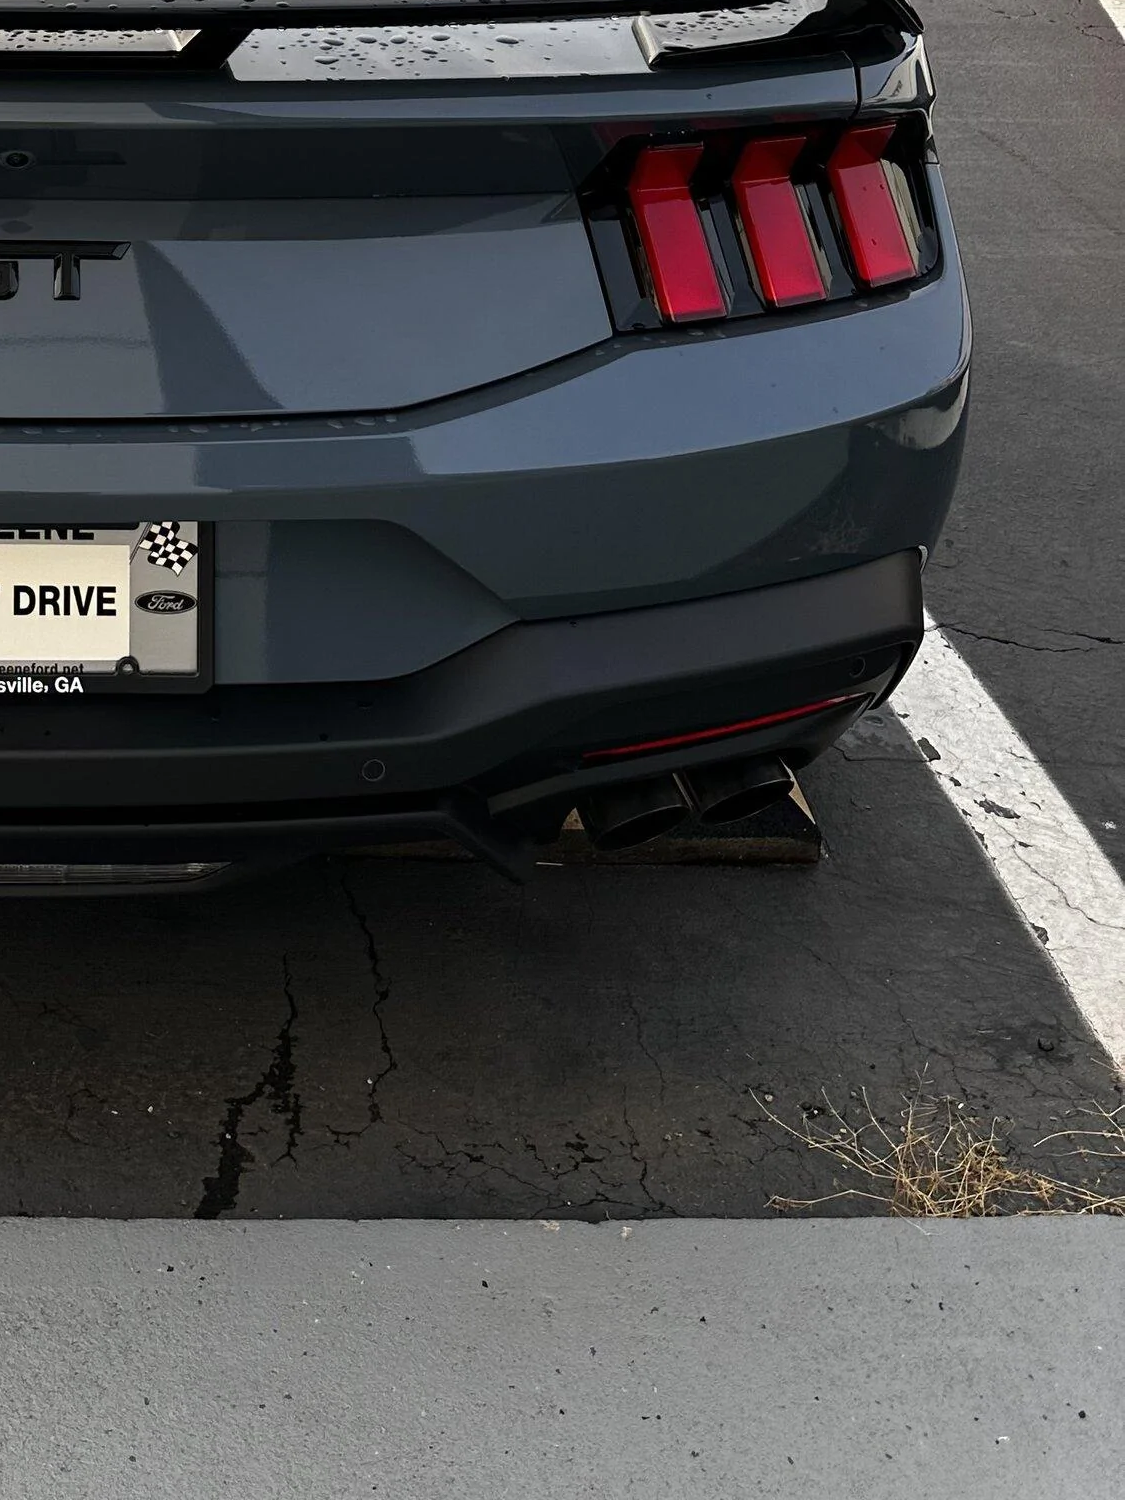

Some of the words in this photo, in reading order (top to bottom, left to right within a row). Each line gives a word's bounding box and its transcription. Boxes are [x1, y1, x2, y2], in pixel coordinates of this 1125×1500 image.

[13, 586, 117, 616] DRIVE
[147, 592, 184, 611] Ford
[54, 676, 84, 693] GA
